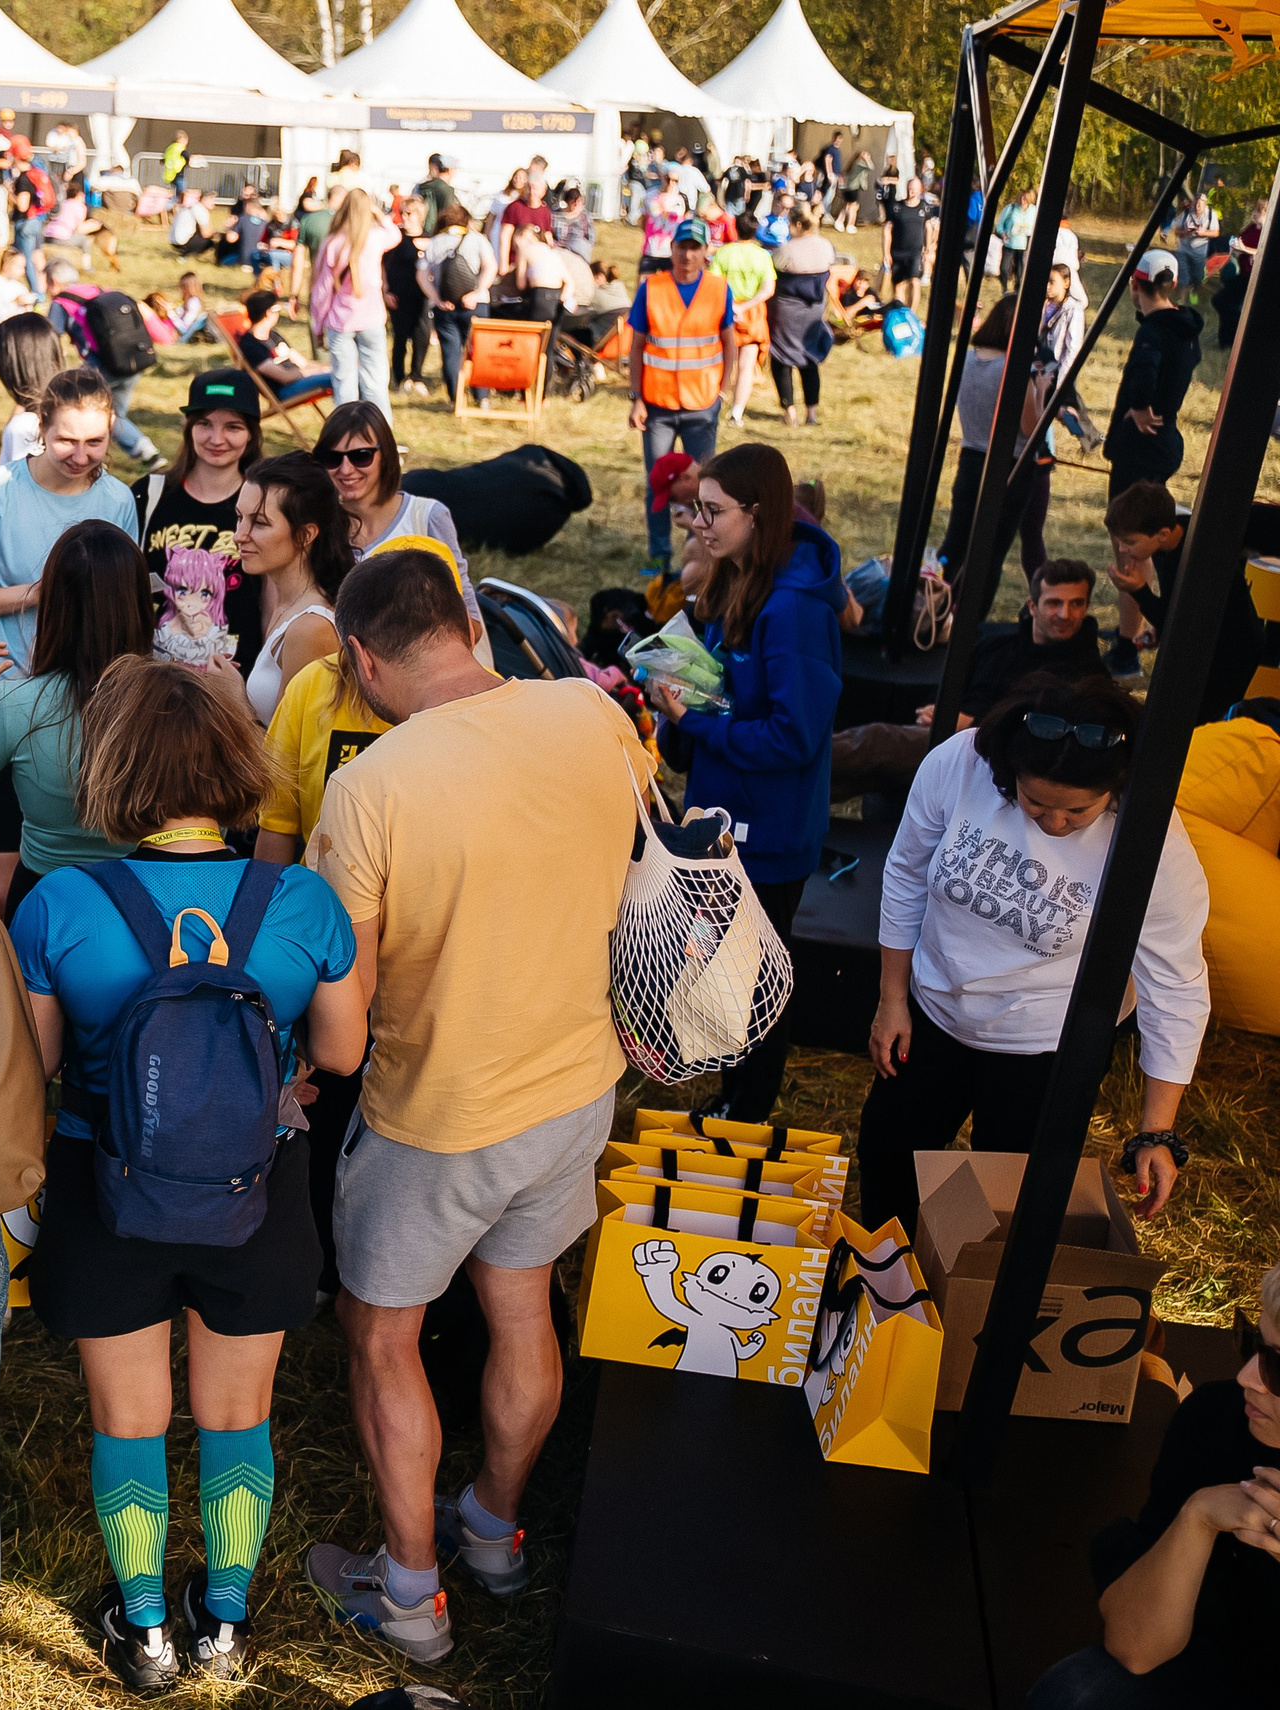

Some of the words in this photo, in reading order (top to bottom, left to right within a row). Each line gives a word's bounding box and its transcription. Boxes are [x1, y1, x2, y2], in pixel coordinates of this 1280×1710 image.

[932, 861, 1073, 950] TODAY?
[940, 848, 978, 881] ON
[973, 868, 1080, 926] BEAUTY
[954, 819, 1048, 891] WHO
[1048, 874, 1093, 912] IS
[141, 1054, 161, 1158] GOODYEAR
[768, 1248, 830, 1387] билайн
[820, 1311, 877, 1460] билайн
[1079, 1401, 1125, 1416] Major
